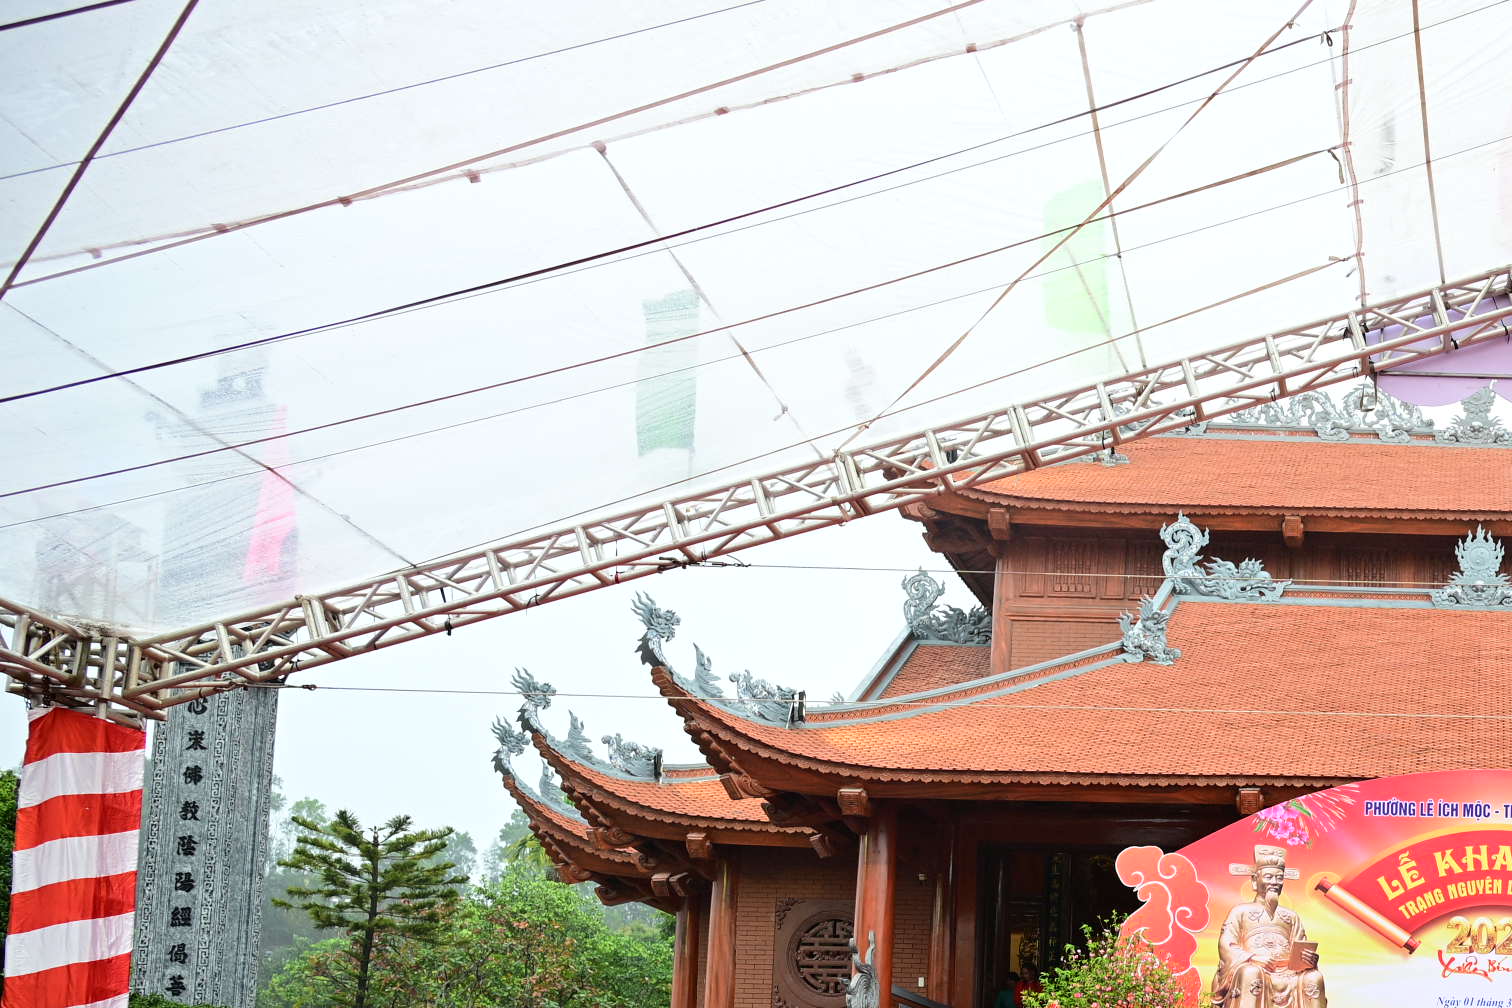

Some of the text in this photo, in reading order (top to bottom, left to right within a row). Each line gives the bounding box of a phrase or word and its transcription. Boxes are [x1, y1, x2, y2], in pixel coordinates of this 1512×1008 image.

[1365, 799, 1416, 817] PHƯỜNG
[1420, 801, 1434, 817] LÊ
[1438, 801, 1459, 818] ÍCH
[1463, 803, 1491, 821] MỘC
[1377, 850, 1425, 900] LỄ
[1398, 890, 1445, 920] TRẠNG
[1447, 876, 1502, 899] NGUYÊN
[1437, 996, 1462, 1008] Ngày
[1463, 997, 1474, 1007] 01
[1476, 997, 1504, 1008] tháng
[1506, 999, 1512, 1007] 3
